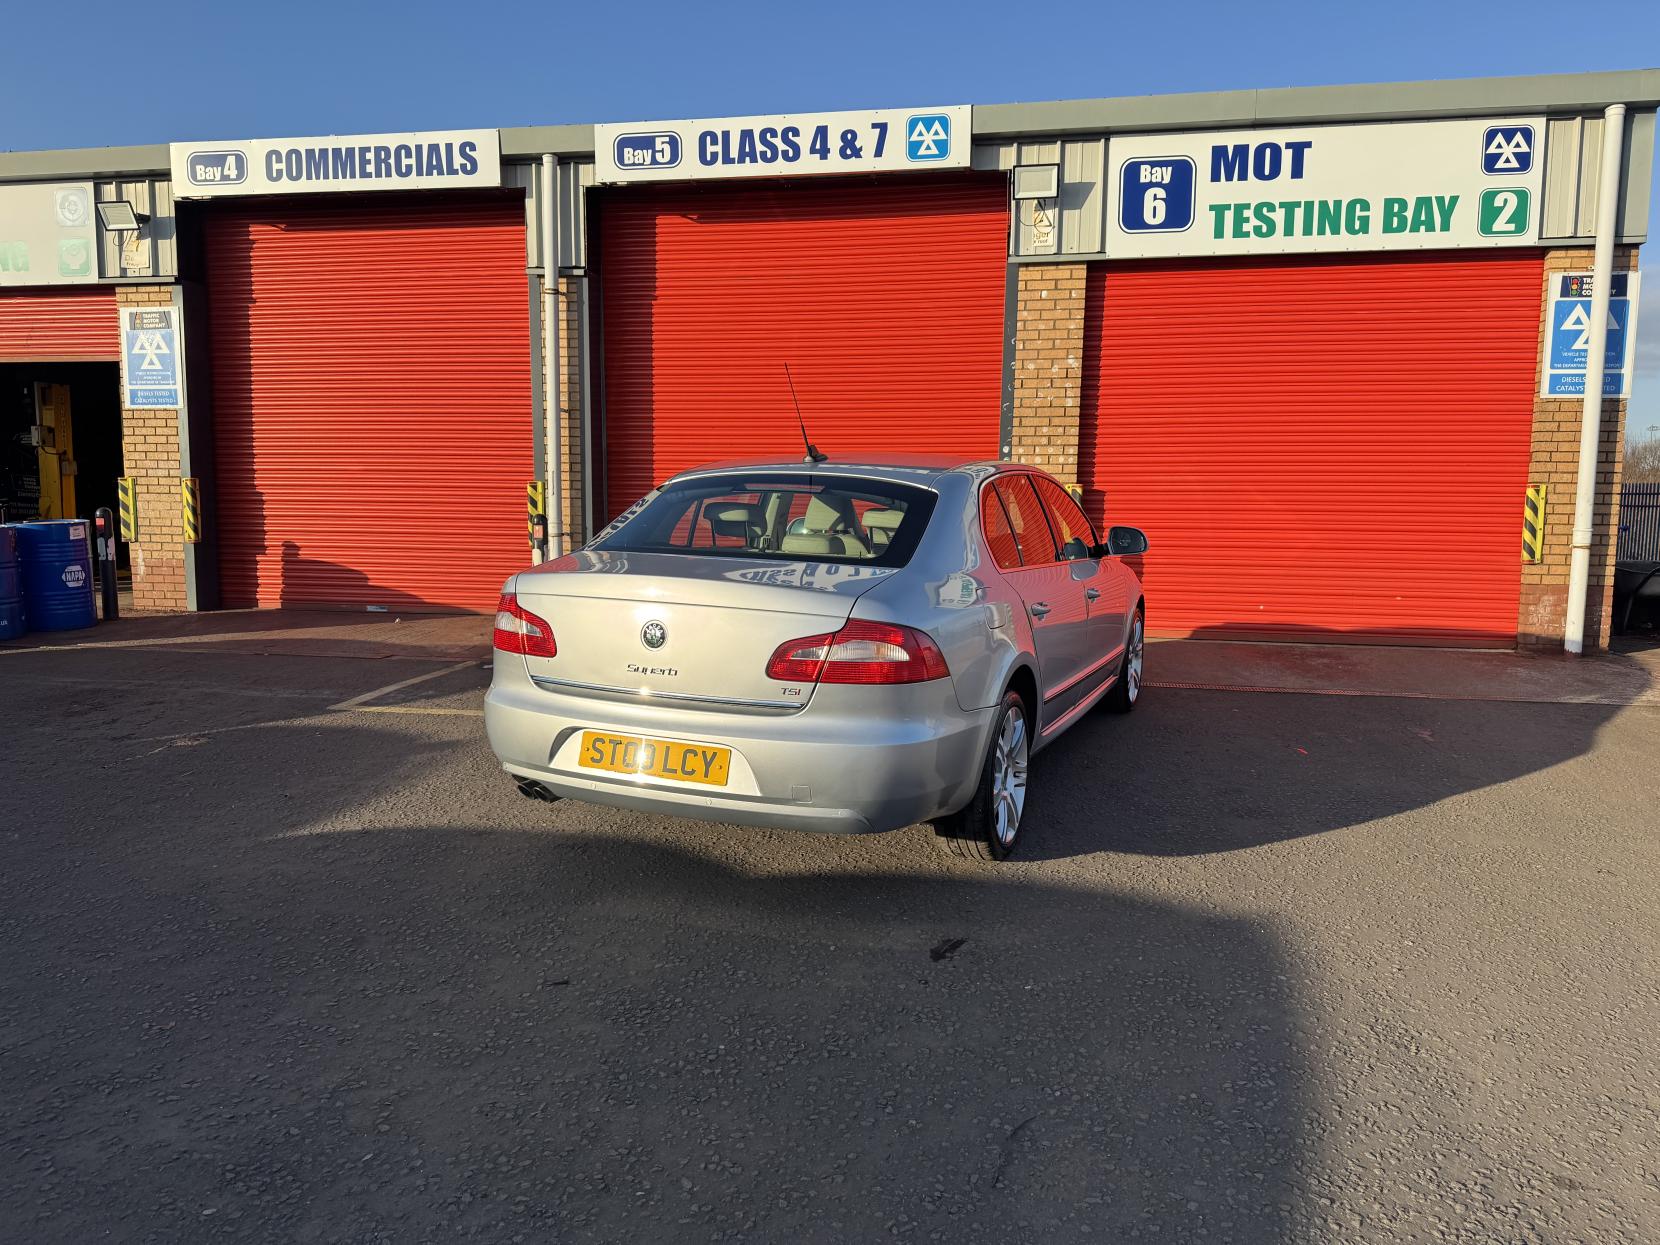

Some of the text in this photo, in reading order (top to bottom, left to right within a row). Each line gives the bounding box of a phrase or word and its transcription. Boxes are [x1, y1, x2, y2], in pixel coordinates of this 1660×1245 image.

[265, 141, 479, 183] COMMERCIALS
[624, 136, 671, 165] Bay 5
[698, 121, 889, 167] CLASS 4 & 7
[1210, 141, 1313, 183] MOT
[196, 155, 238, 181] Bay 4
[1139, 164, 1172, 225] Bay 6
[1491, 191, 1519, 232] 2
[1209, 194, 1460, 240] TESTING BAY
[627, 663, 678, 676] Superb
[662, 746, 718, 779] LCY
